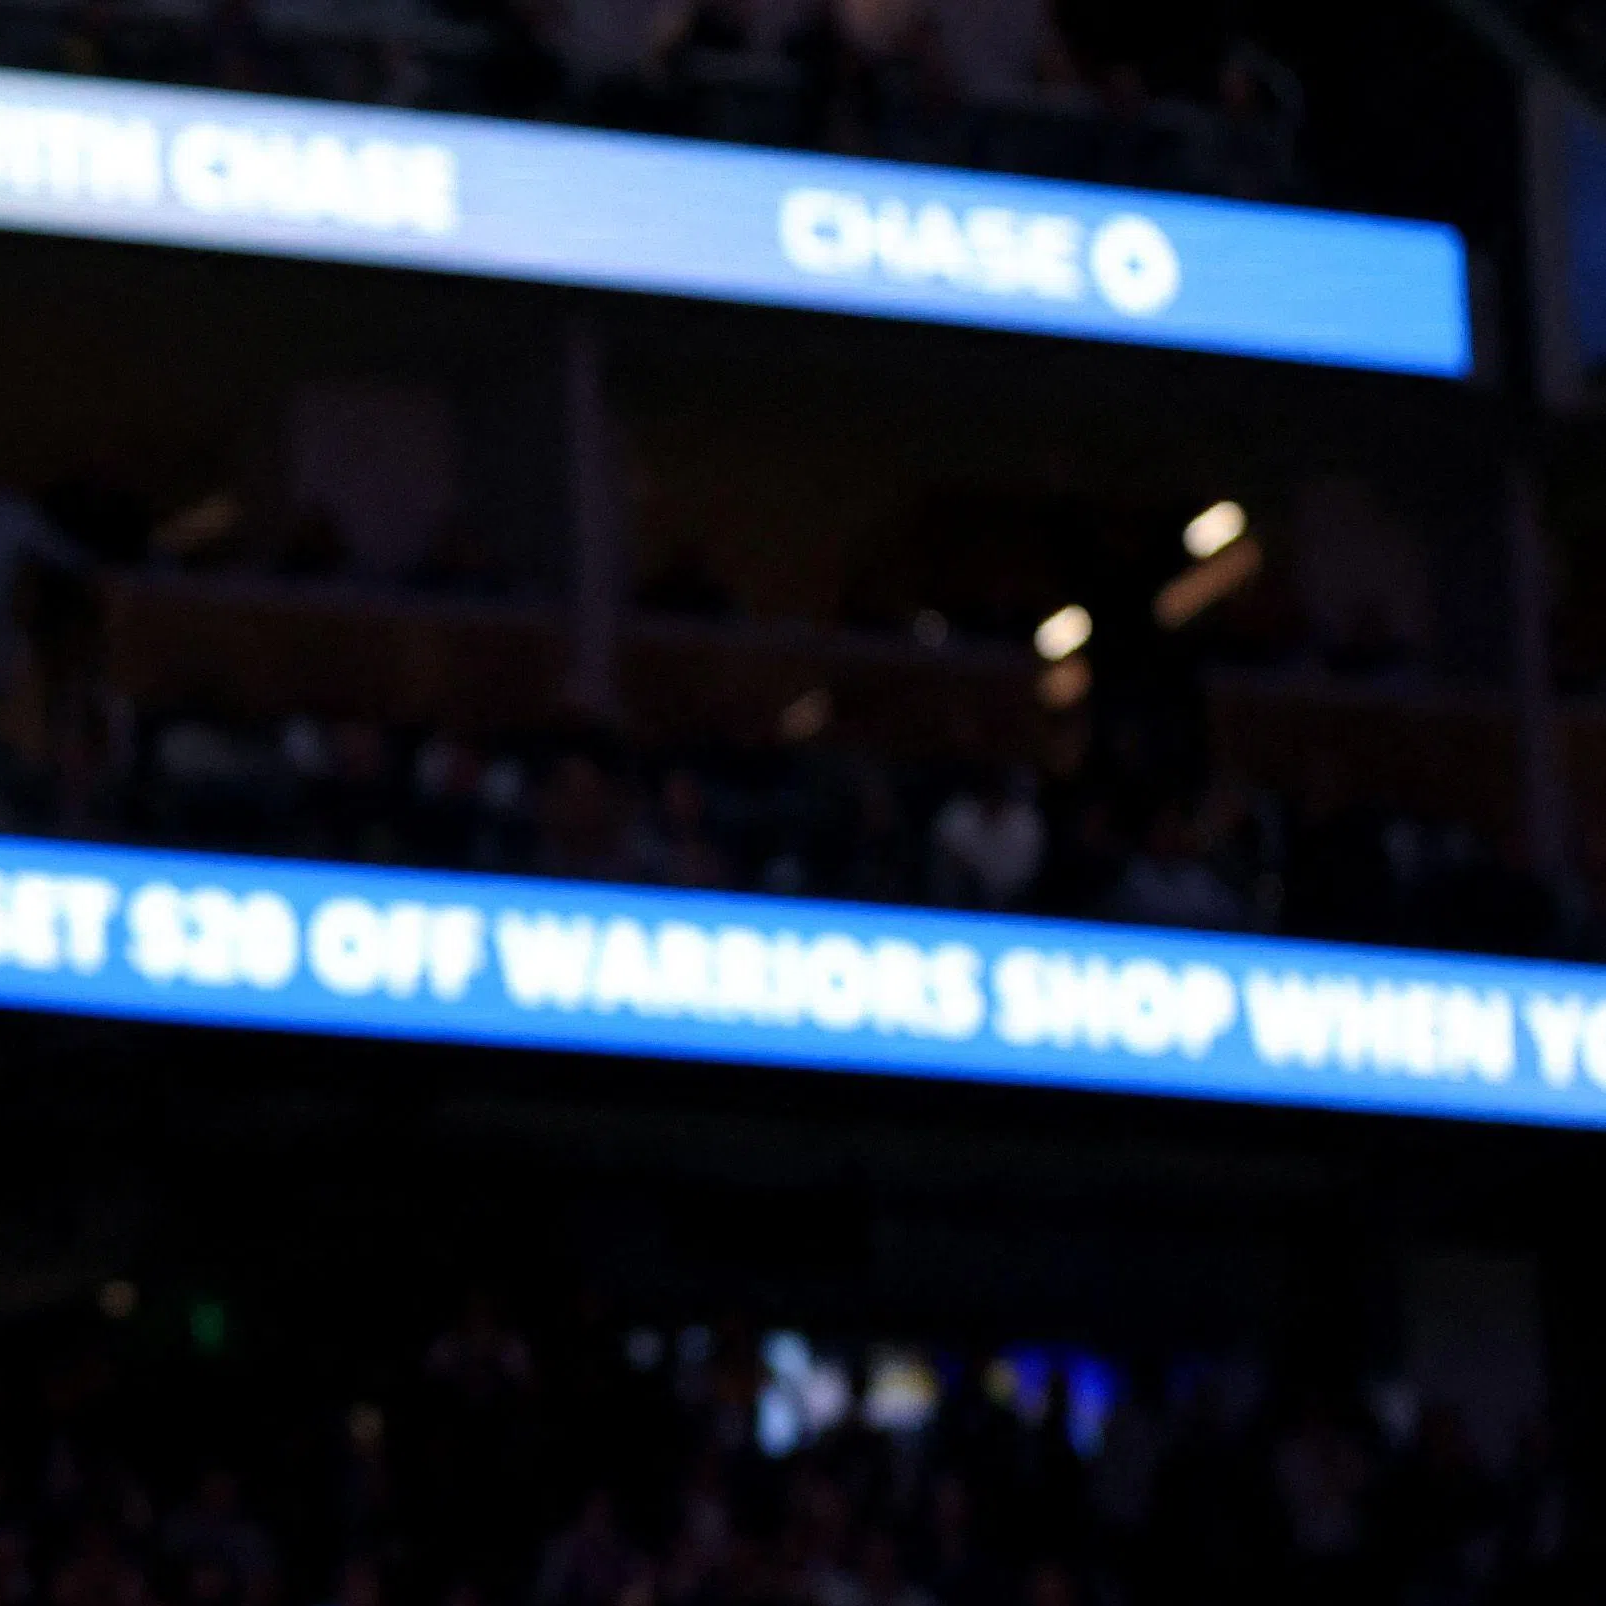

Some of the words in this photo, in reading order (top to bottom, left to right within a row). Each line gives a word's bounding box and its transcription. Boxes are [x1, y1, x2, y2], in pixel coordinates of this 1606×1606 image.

[171, 123, 453, 232] CHASE
[777, 186, 1085, 302] CHASE
[127, 882, 301, 990] $20
[306, 897, 486, 1002] OFF
[494, 911, 986, 1040] WARRIORS
[992, 947, 1238, 1058] SHOP
[1241, 969, 1517, 1084] WHEN
